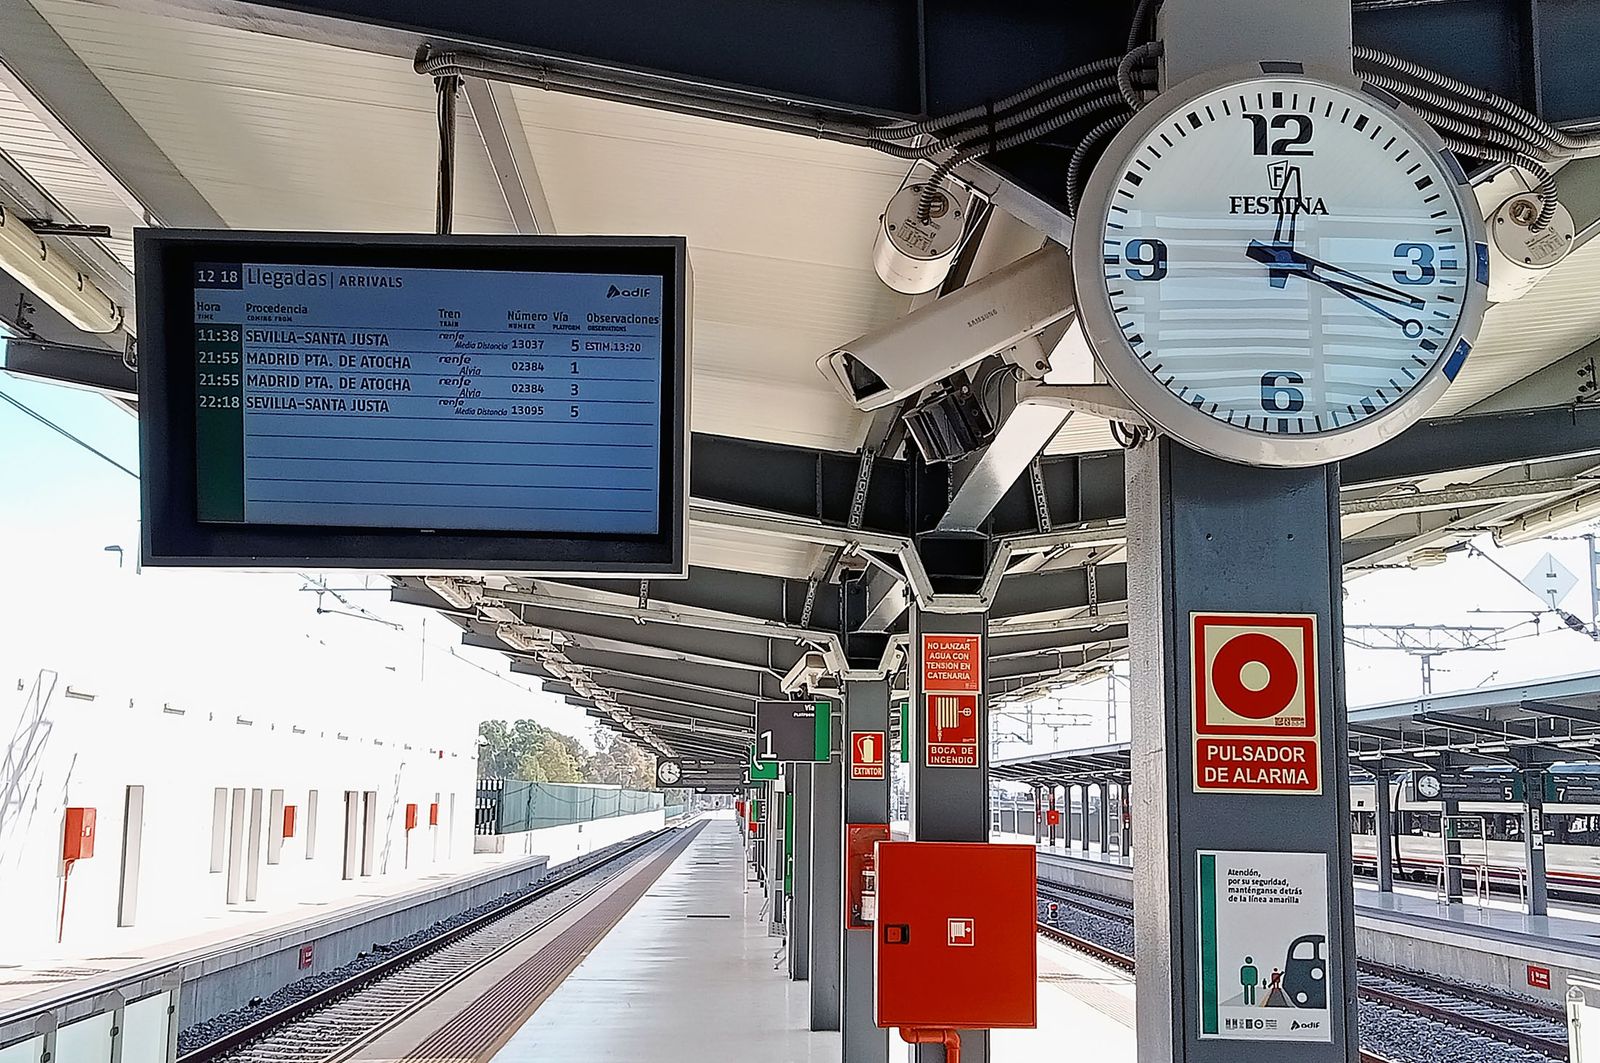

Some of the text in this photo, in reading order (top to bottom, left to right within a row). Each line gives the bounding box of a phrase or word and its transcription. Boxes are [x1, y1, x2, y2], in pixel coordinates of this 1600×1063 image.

[1242, 113, 1314, 156] 12
[1229, 196, 1329, 216] FESTINA
[1124, 238, 1168, 281] 9
[1391, 243, 1436, 285] 3
[198, 270, 238, 283] 12 18
[248, 268, 403, 289] Llegadas ARRIVALS
[197, 302, 221, 312] Hora
[246, 303, 309, 315] Procedencia
[438, 308, 461, 319] Tren
[507, 309, 548, 321] Número
[553, 311, 569, 322] Vía
[586, 312, 660, 325] Observaciones
[967, 308, 998, 328] SAMSUNG
[198, 329, 389, 347] 11:38 SEVILLA-SANTA JUSTA
[439, 331, 464, 341] renfe
[455, 341, 508, 350] Media Distancia
[511, 340, 545, 350] 13037
[571, 339, 580, 352] 5
[199, 351, 411, 369] 21:55 MADRID PTA. DE ATOCHA
[438, 353, 471, 366] renfe
[459, 366, 481, 376] Alvia
[511, 361, 545, 372] 02384
[571, 362, 580, 374] 1
[199, 373, 411, 391] 21:55 MADRID PTA. DE ATOCHA
[438, 376, 471, 388] renfe
[459, 388, 481, 398] Alvia
[511, 383, 545, 394] 02384
[570, 384, 579, 396] 3
[1260, 370, 1304, 413] 6
[199, 395, 389, 413] 22:18 SEVILLA-SANTA JUSTA
[438, 398, 464, 407] renfe
[455, 407, 508, 416] Media Distancia
[511, 405, 544, 415] 13095
[570, 406, 579, 418] 5
[929, 652, 951, 660] AGUA
[926, 661, 971, 670] TENSION EN
[927, 671, 970, 680] CATENARIA
[760, 730, 777, 759] 1
[931, 746, 973, 755] BOCA DE
[1207, 745, 1306, 762] PULSADOR
[931, 756, 974, 764] INCENDIO
[854, 767, 882, 776] EXTINTOR
[1205, 767, 1309, 784] DE ALARMA
[1504, 787, 1513, 800] 5
[1556, 788, 1566, 801] 7
[1227, 868, 1261, 878] Atención,
[1228, 878, 1240, 886] por
[1251, 878, 1289, 887] seguridad,
[1228, 886, 1303, 895] manténganse detrás
[1248, 895, 1267, 903] línea
[1268, 896, 1299, 904] amarilla
